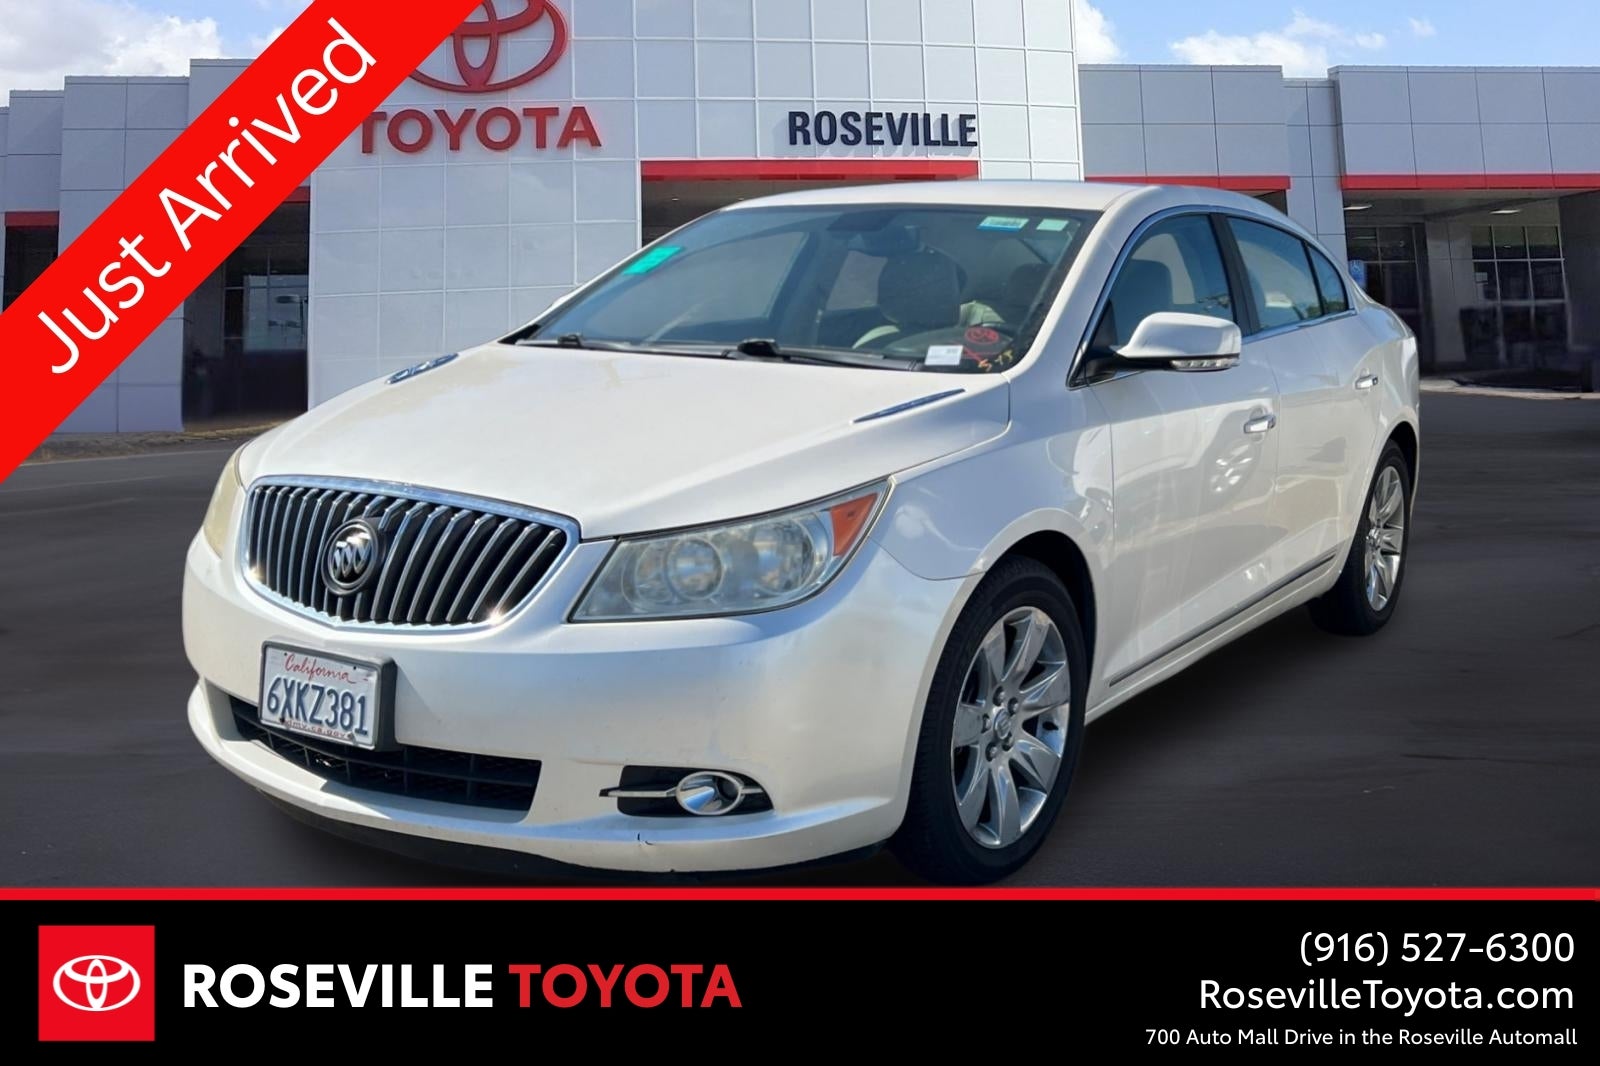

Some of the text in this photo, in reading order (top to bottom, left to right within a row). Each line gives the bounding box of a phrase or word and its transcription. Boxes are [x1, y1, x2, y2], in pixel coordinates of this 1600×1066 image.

[361, 106, 602, 154] TOYOTA
[788, 111, 978, 147] ROSEVILLE
[285, 653, 357, 684] California
[267, 677, 369, 736] 6XKZ381
